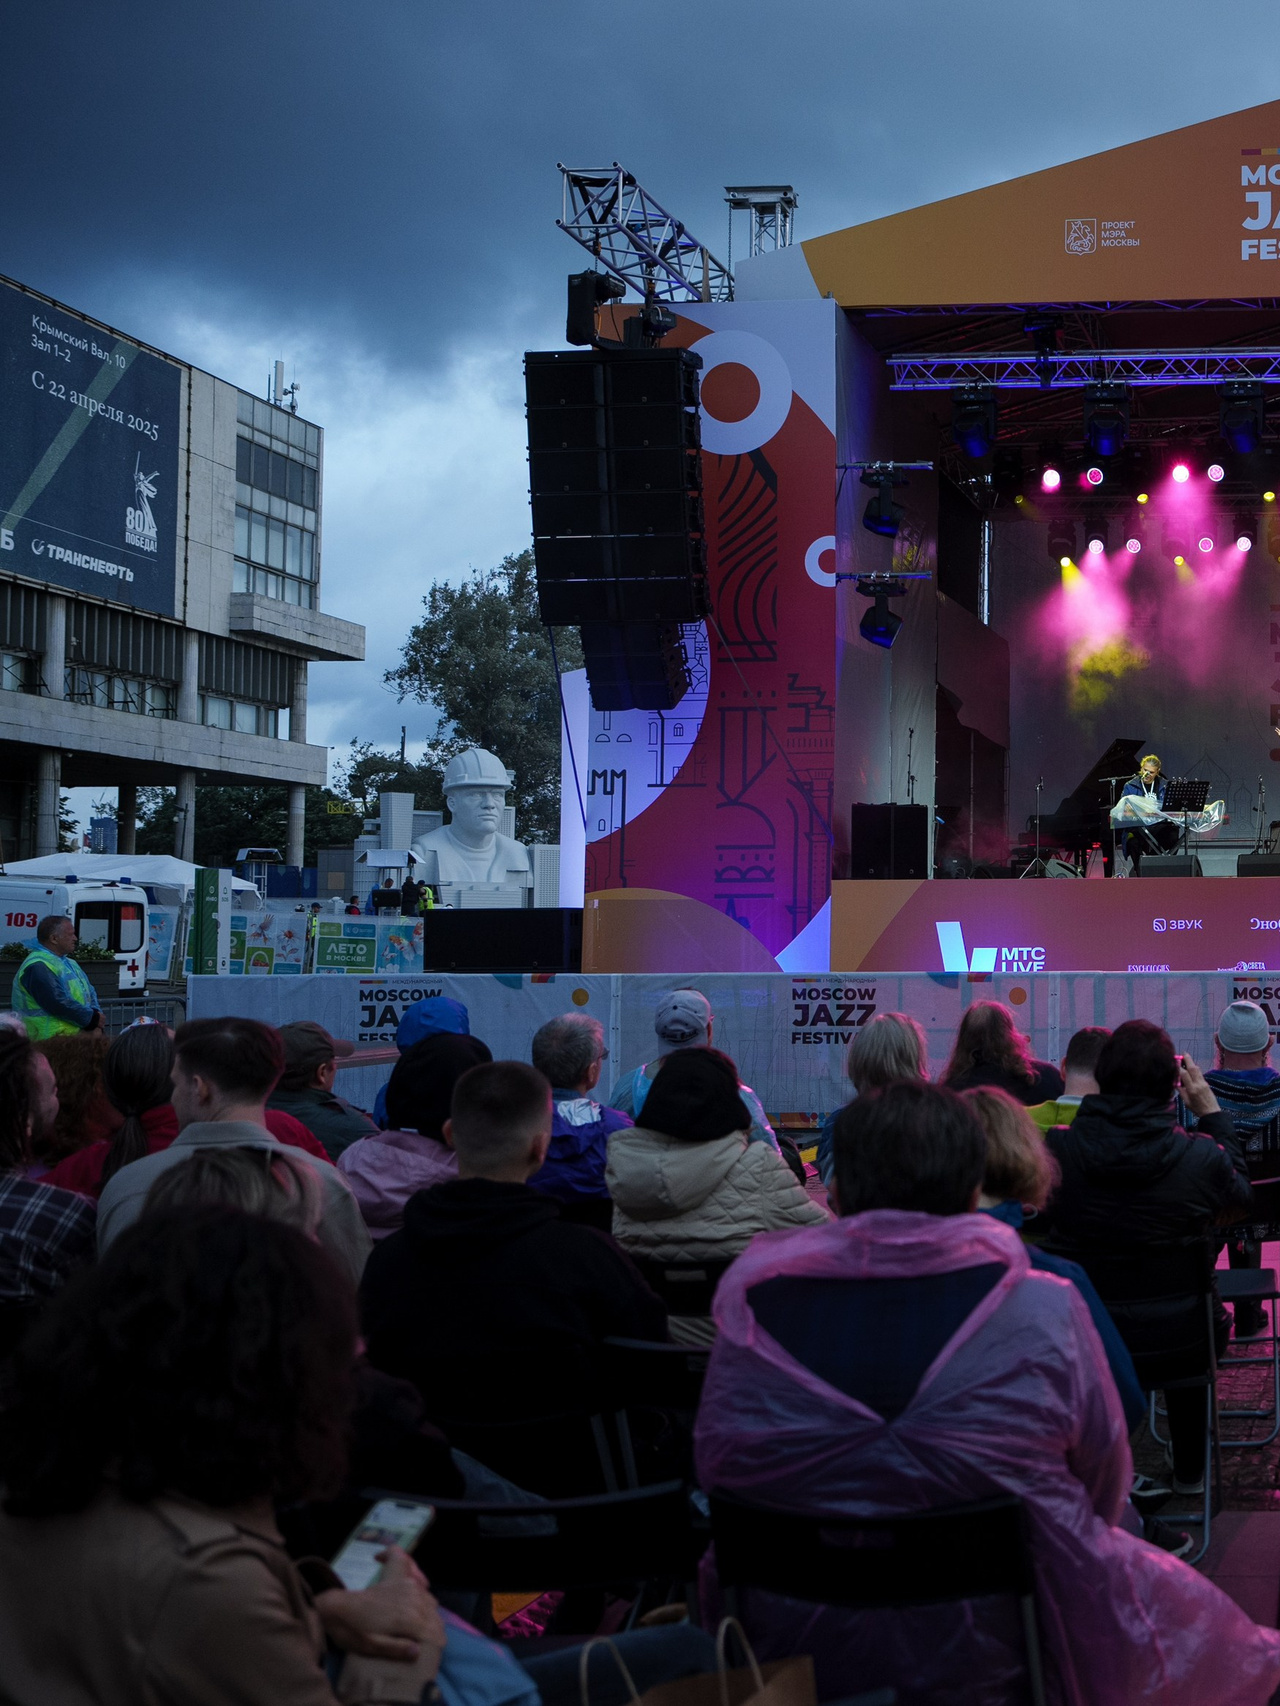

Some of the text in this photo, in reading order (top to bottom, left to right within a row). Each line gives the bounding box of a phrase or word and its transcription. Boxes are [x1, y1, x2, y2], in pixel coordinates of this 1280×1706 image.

[1101, 221, 1136, 229] ПРОЕКТ
[1101, 230, 1127, 238] МЭРА
[1101, 238, 1140, 247] МОСКВЫ
[31, 314, 126, 369] Крымский Вал, 10
[31, 334, 51, 354] Зал
[31, 369, 160, 442] С 22 апреля 2025
[126, 506, 144, 533] 80
[125, 531, 158, 553] ПОБЕДА!
[47, 543, 135, 583] ТРАНСНЕФТЬ
[5, 912, 38, 928] 103
[1169, 919, 1203, 930] ЗВУК
[327, 942, 367, 955] ЛЕТО
[359, 989, 442, 1002] MOSCOW
[792, 987, 876, 1001] MOSCOW
[359, 1005, 411, 1028] JA
[792, 1003, 876, 1027] JAZZ
[791, 1032, 856, 1045] FESTIV
